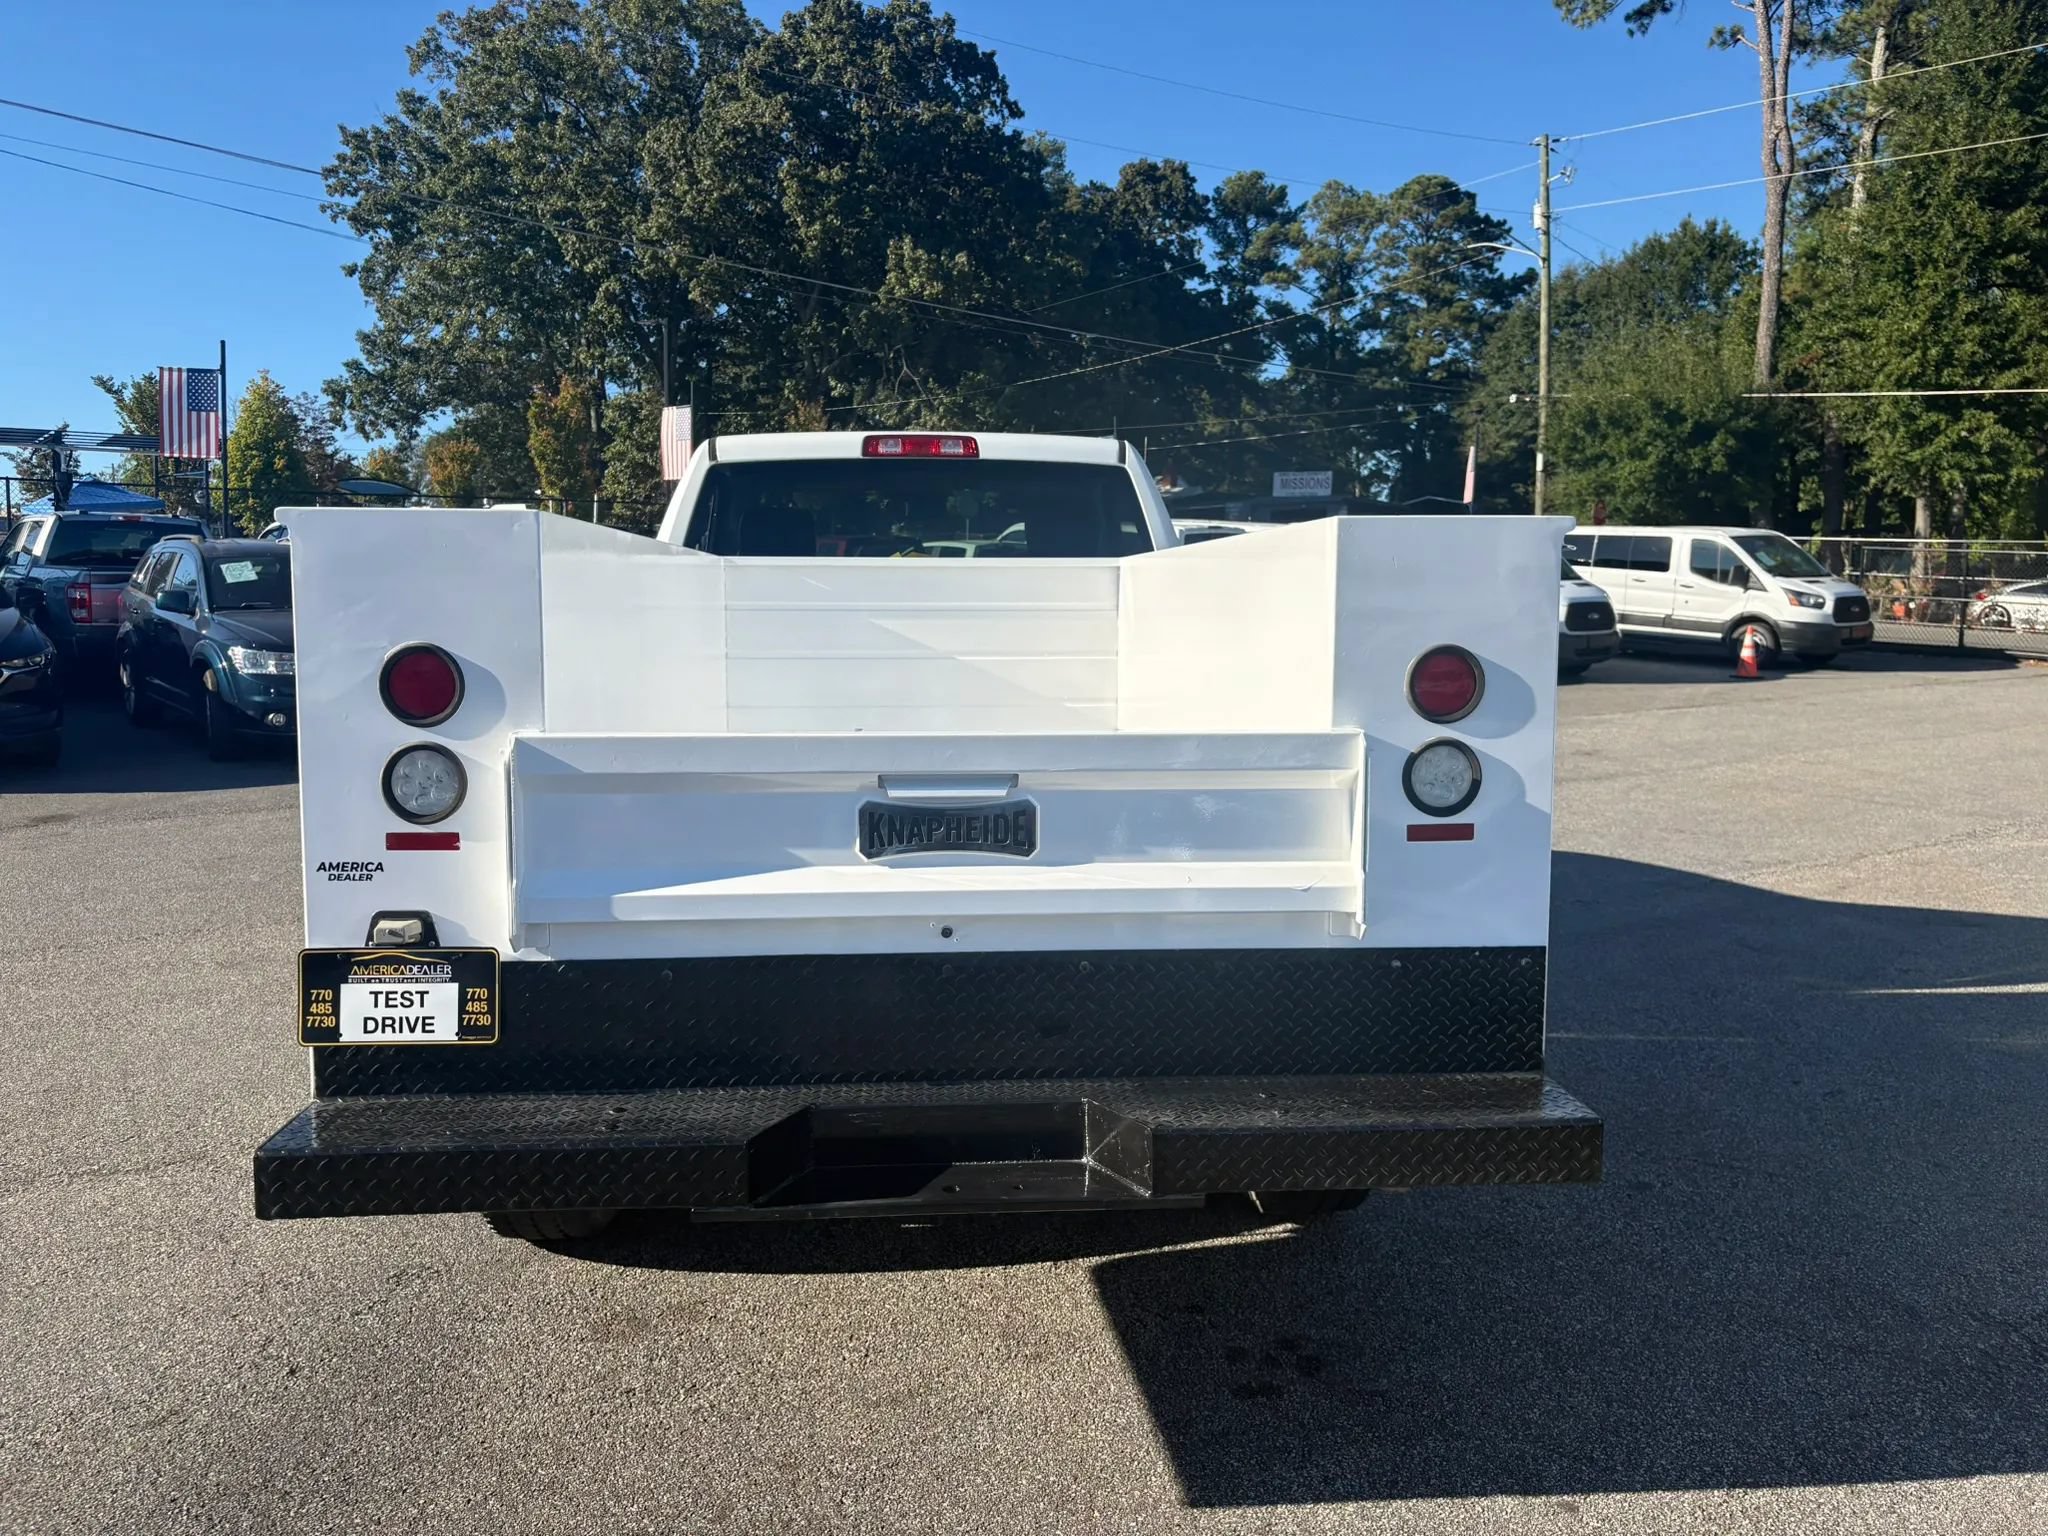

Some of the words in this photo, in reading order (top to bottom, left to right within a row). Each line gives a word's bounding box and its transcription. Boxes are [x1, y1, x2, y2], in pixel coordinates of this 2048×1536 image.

[1280, 476, 1330, 490] MISSIONS
[867, 809, 1028, 850] KNAPHEIDE
[316, 861, 384, 873] AMERICA
[327, 873, 373, 882] DEALER
[351, 965, 452, 976] AMERICADEALER
[310, 989, 333, 1001] 770
[369, 990, 430, 1009] TEST
[465, 988, 488, 999] 770
[309, 1002, 333, 1014] 485
[465, 1001, 488, 1012] 485
[306, 1016, 336, 1028] 7730
[362, 1015, 436, 1034] DRIVE
[462, 1014, 491, 1026] 7730
